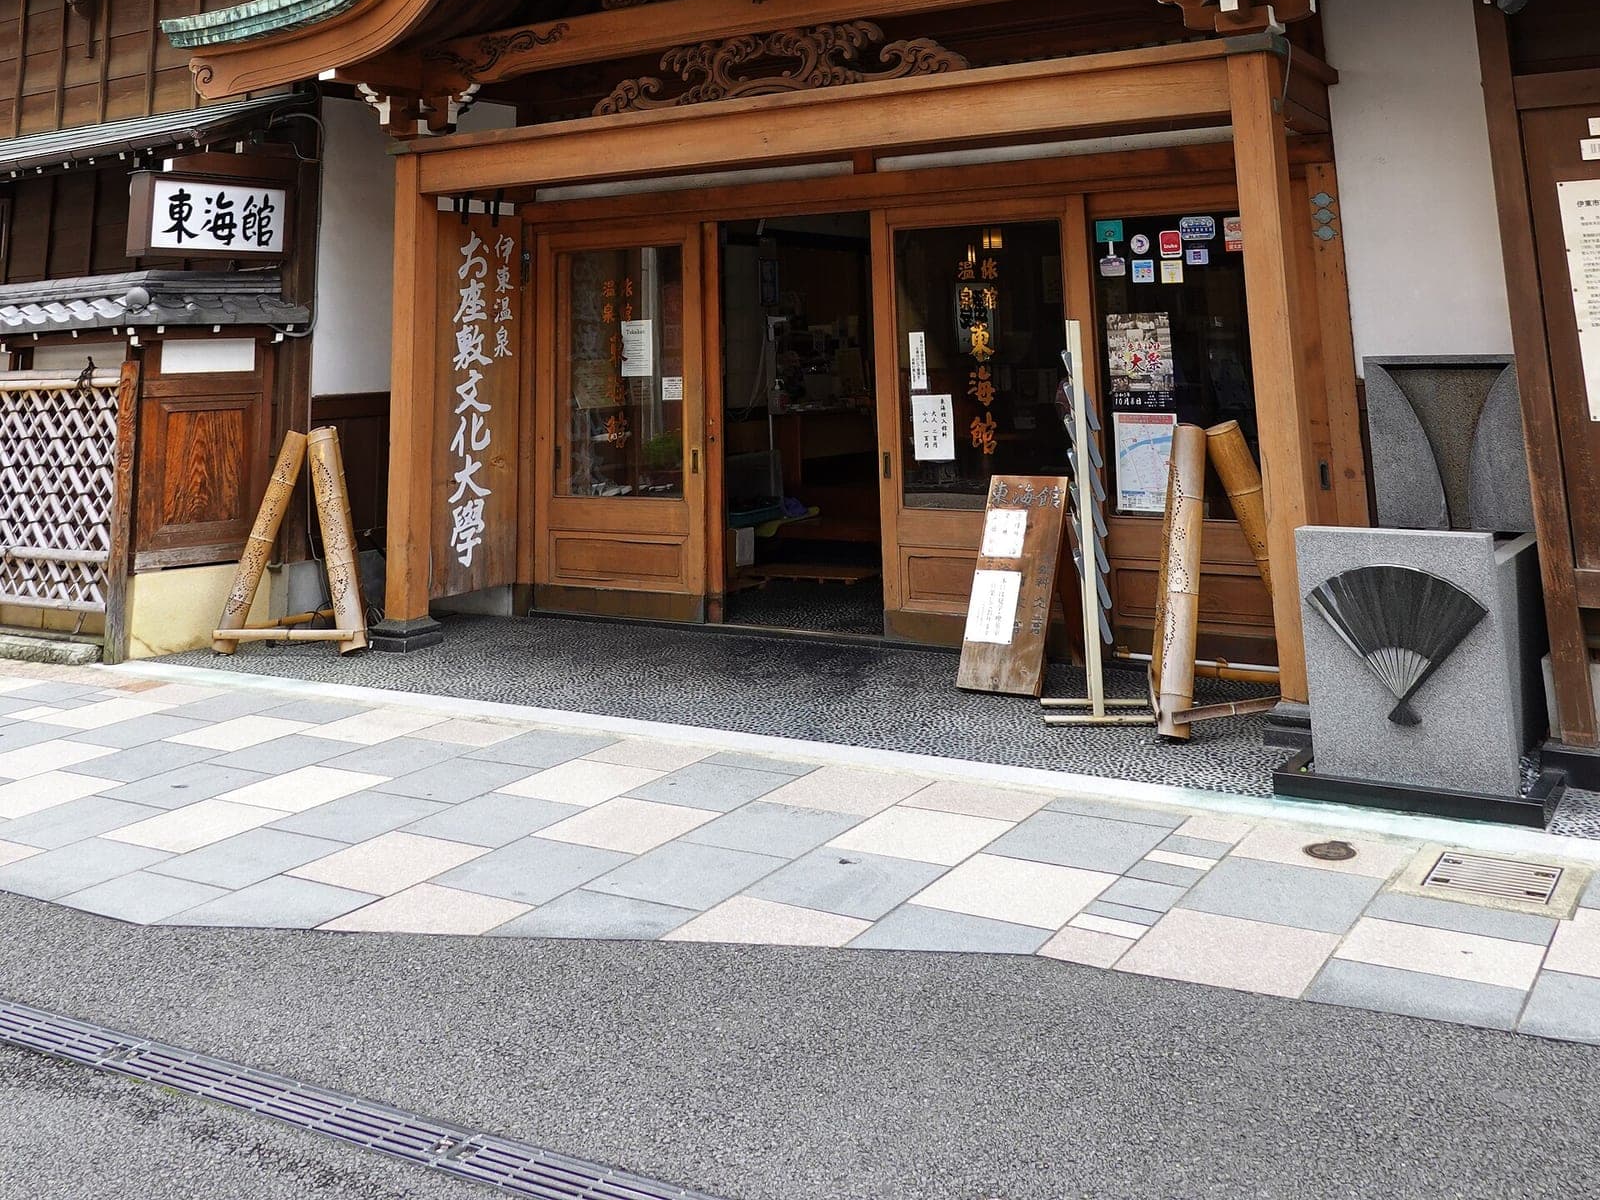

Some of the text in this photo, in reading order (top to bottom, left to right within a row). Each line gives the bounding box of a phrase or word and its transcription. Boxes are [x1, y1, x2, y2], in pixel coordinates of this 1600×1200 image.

[162, 188, 275, 247] 東海館
[1576, 199, 1600, 209] 伊東市
[493, 232, 515, 359] 伊東温泉
[958, 260, 976, 309] 温泉
[968, 322, 997, 455] 東海館
[1128, 352, 1163, 373] 大祭
[447, 231, 493, 568] お座敷文化大學
[991, 481, 1064, 509] 東海館
